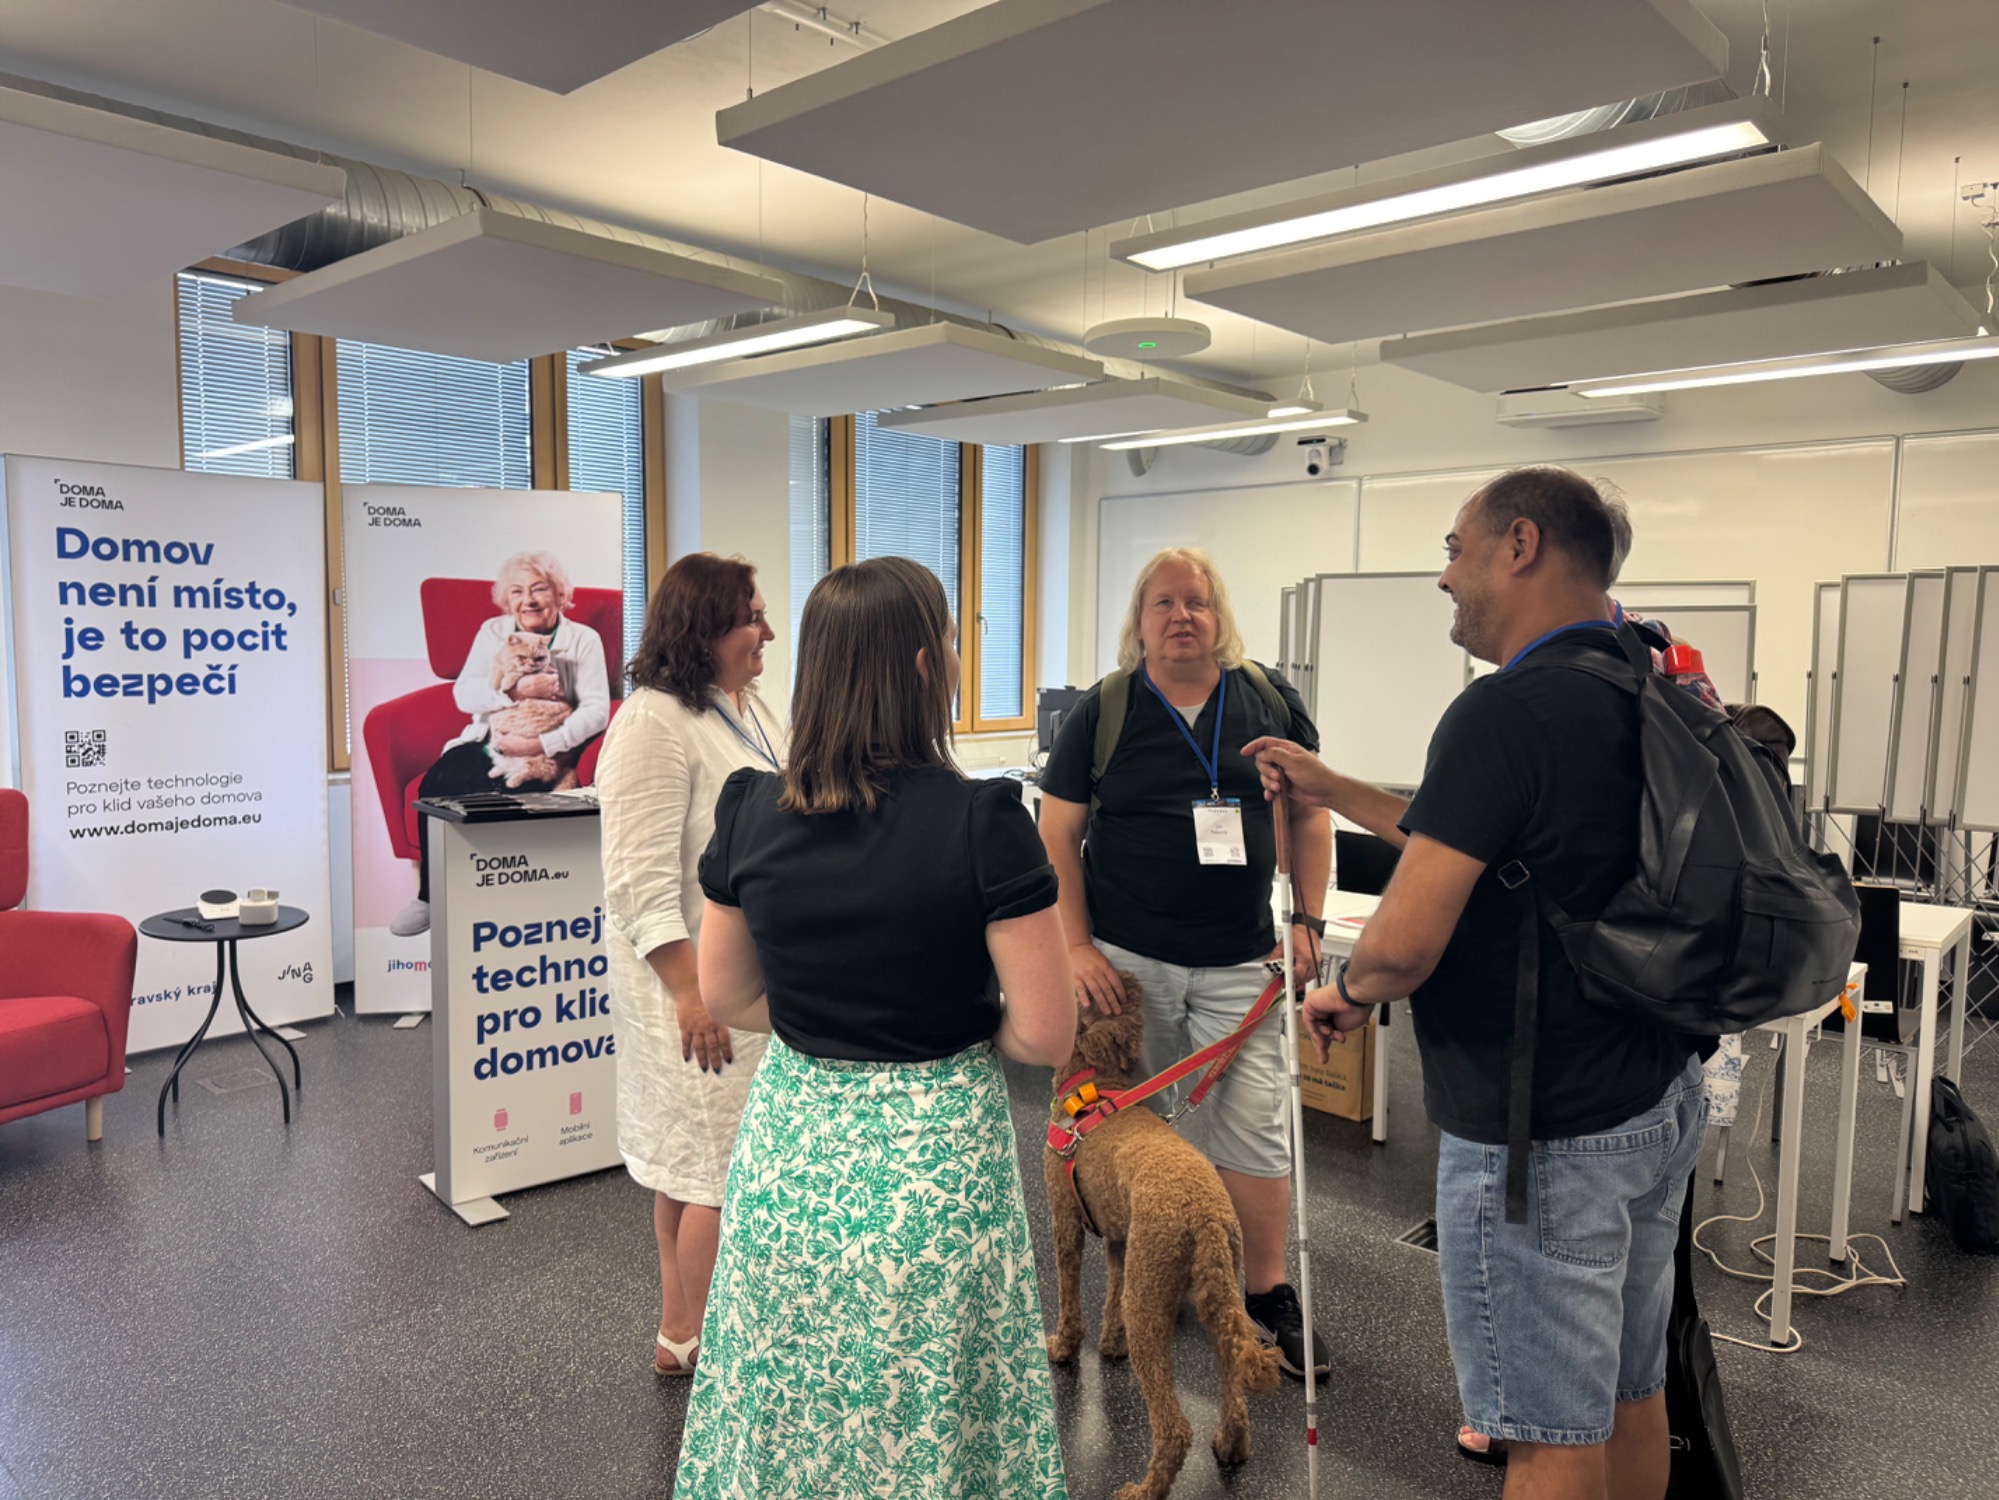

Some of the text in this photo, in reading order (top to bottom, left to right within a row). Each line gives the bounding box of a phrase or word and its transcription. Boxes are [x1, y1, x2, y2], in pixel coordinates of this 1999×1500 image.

[59, 484, 106, 497] DOMA
[60, 497, 124, 511] JE DOMA
[367, 506, 406, 516] DOMA
[368, 517, 422, 527] JE DOMA
[56, 527, 214, 565] Domov
[58, 575, 297, 617] není místo,
[62, 617, 288, 660] je to pocit
[62, 664, 239, 705] bezpečí
[66, 772, 243, 796] Poznejte technologie
[67, 791, 262, 818] pro klid vašeho domova
[69, 813, 262, 839] www.domajedoma.eu
[476, 855, 529, 872] DOMA
[476, 873, 494, 887] JE
[473, 906, 606, 952] Poznej
[477, 1006, 542, 1045] pro
[473, 1135, 529, 1154] Komunikační
[559, 1132, 593, 1146] aplikace
